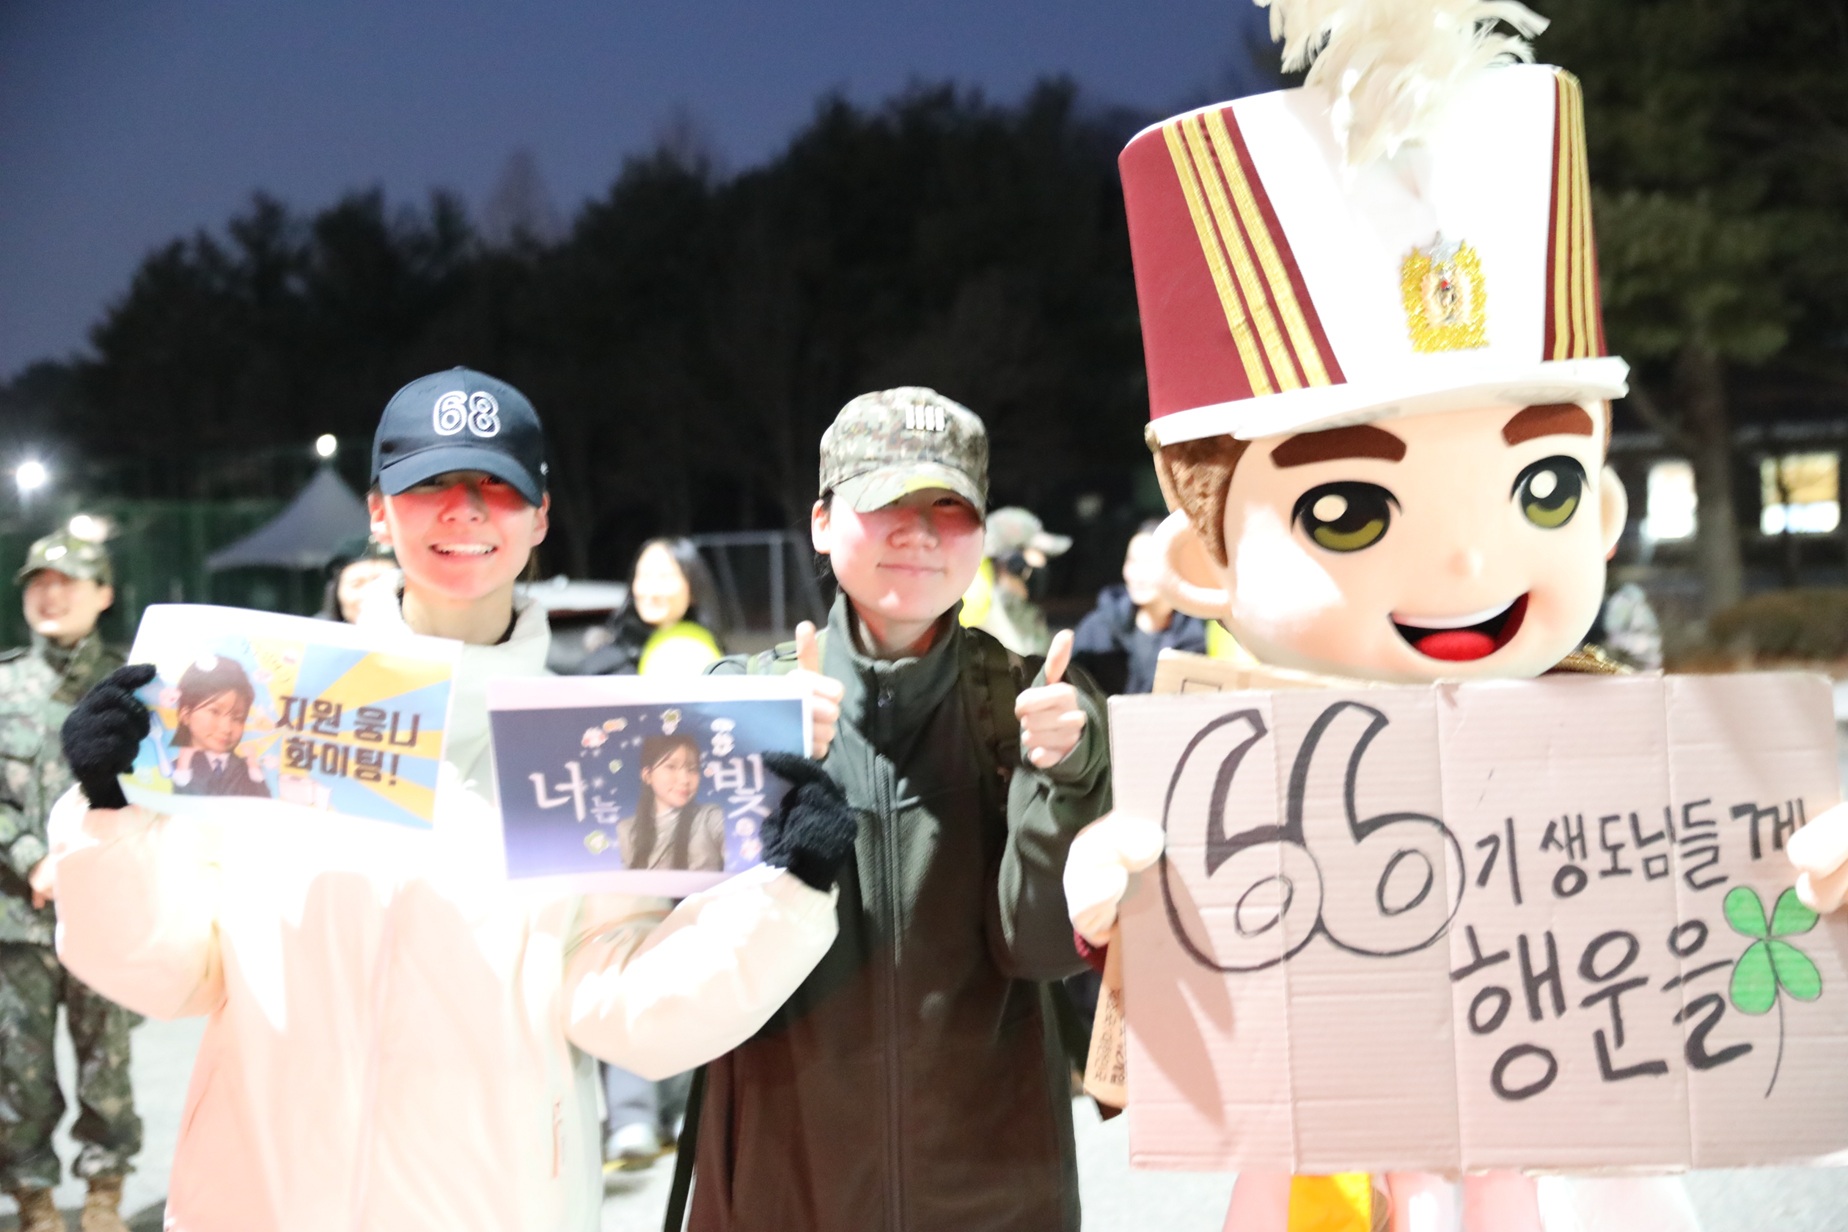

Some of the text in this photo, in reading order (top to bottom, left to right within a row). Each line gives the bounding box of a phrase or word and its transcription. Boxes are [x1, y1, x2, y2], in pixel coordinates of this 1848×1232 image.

[433, 390, 501, 438] 68
[275, 696, 343, 737] 지원
[285, 737, 400, 786] 화이팅!
[1450, 923, 1753, 1102] 행운을
